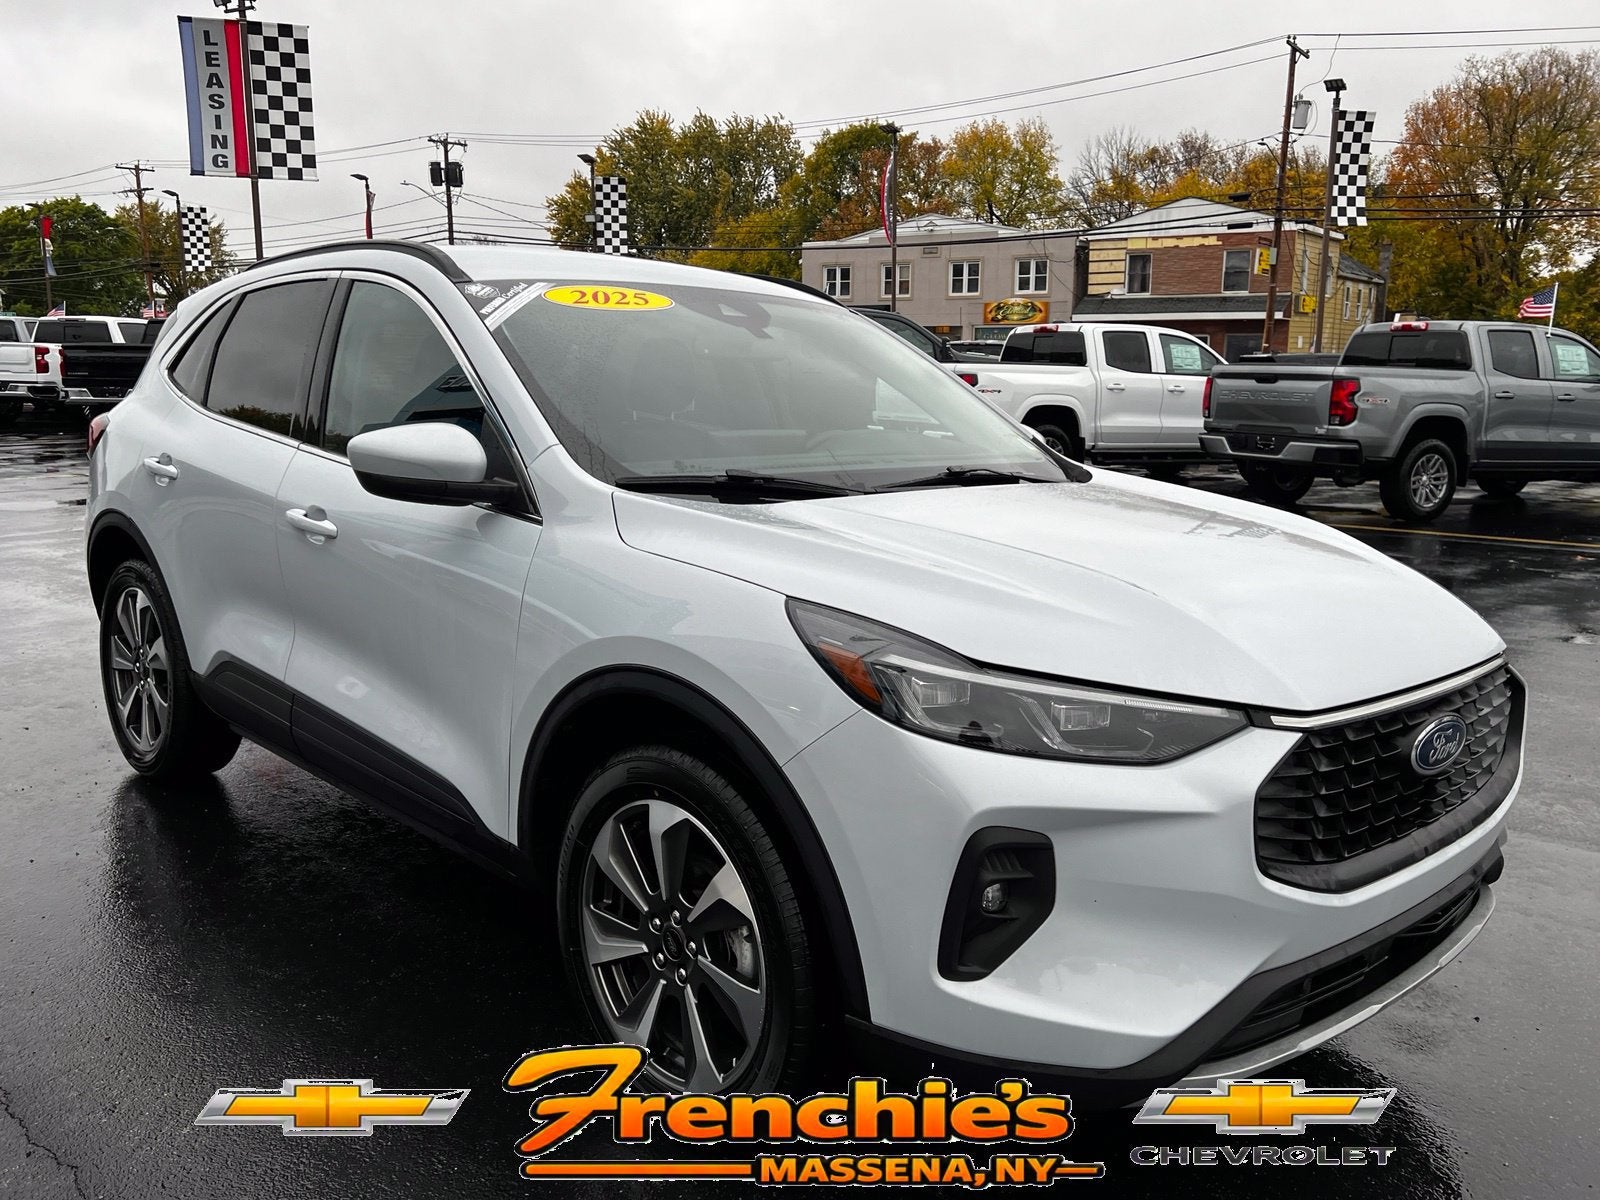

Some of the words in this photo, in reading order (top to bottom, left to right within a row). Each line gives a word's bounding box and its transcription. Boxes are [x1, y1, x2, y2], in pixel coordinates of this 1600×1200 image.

[203, 29, 229, 168] LEASING
[569, 290, 649, 306] 2025
[1219, 390, 1314, 402] CHEVROLET
[1429, 729, 1460, 763] Ford
